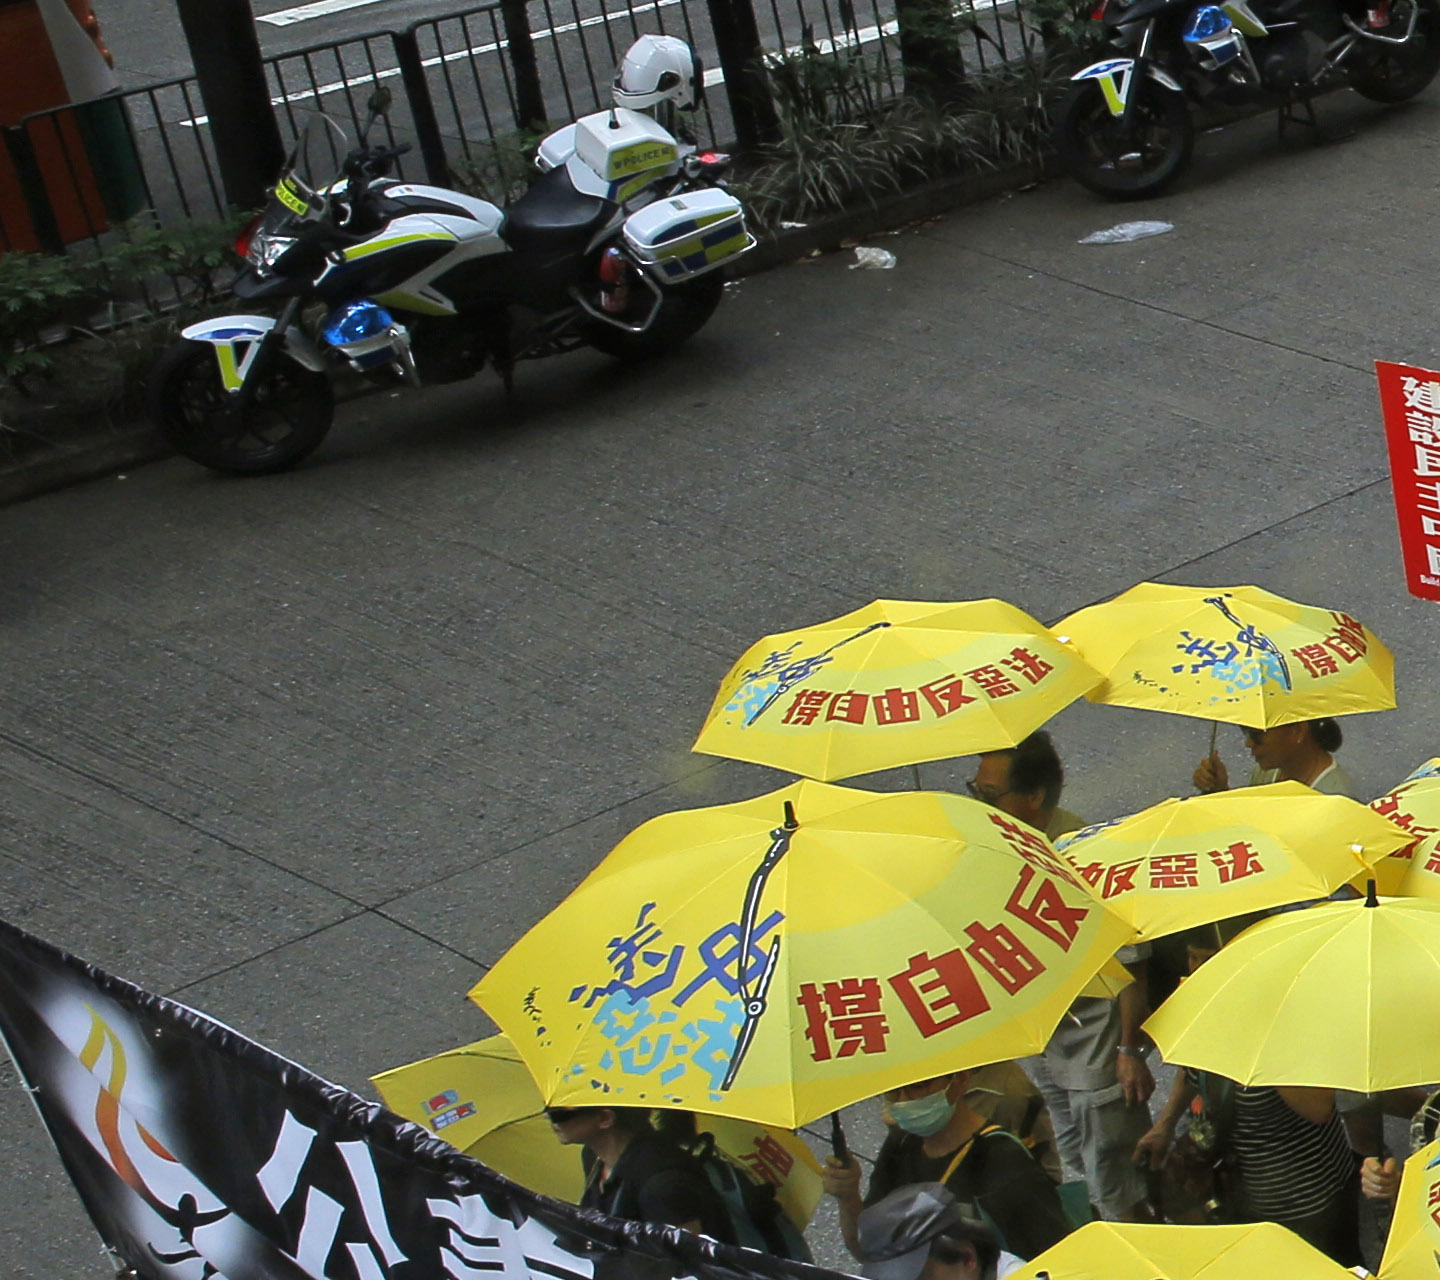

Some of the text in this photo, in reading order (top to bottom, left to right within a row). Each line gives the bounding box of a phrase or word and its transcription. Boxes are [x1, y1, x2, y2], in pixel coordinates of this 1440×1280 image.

[1420, 574, 1440, 588] Build
[781, 648, 1052, 726] 撐自由反惡法
